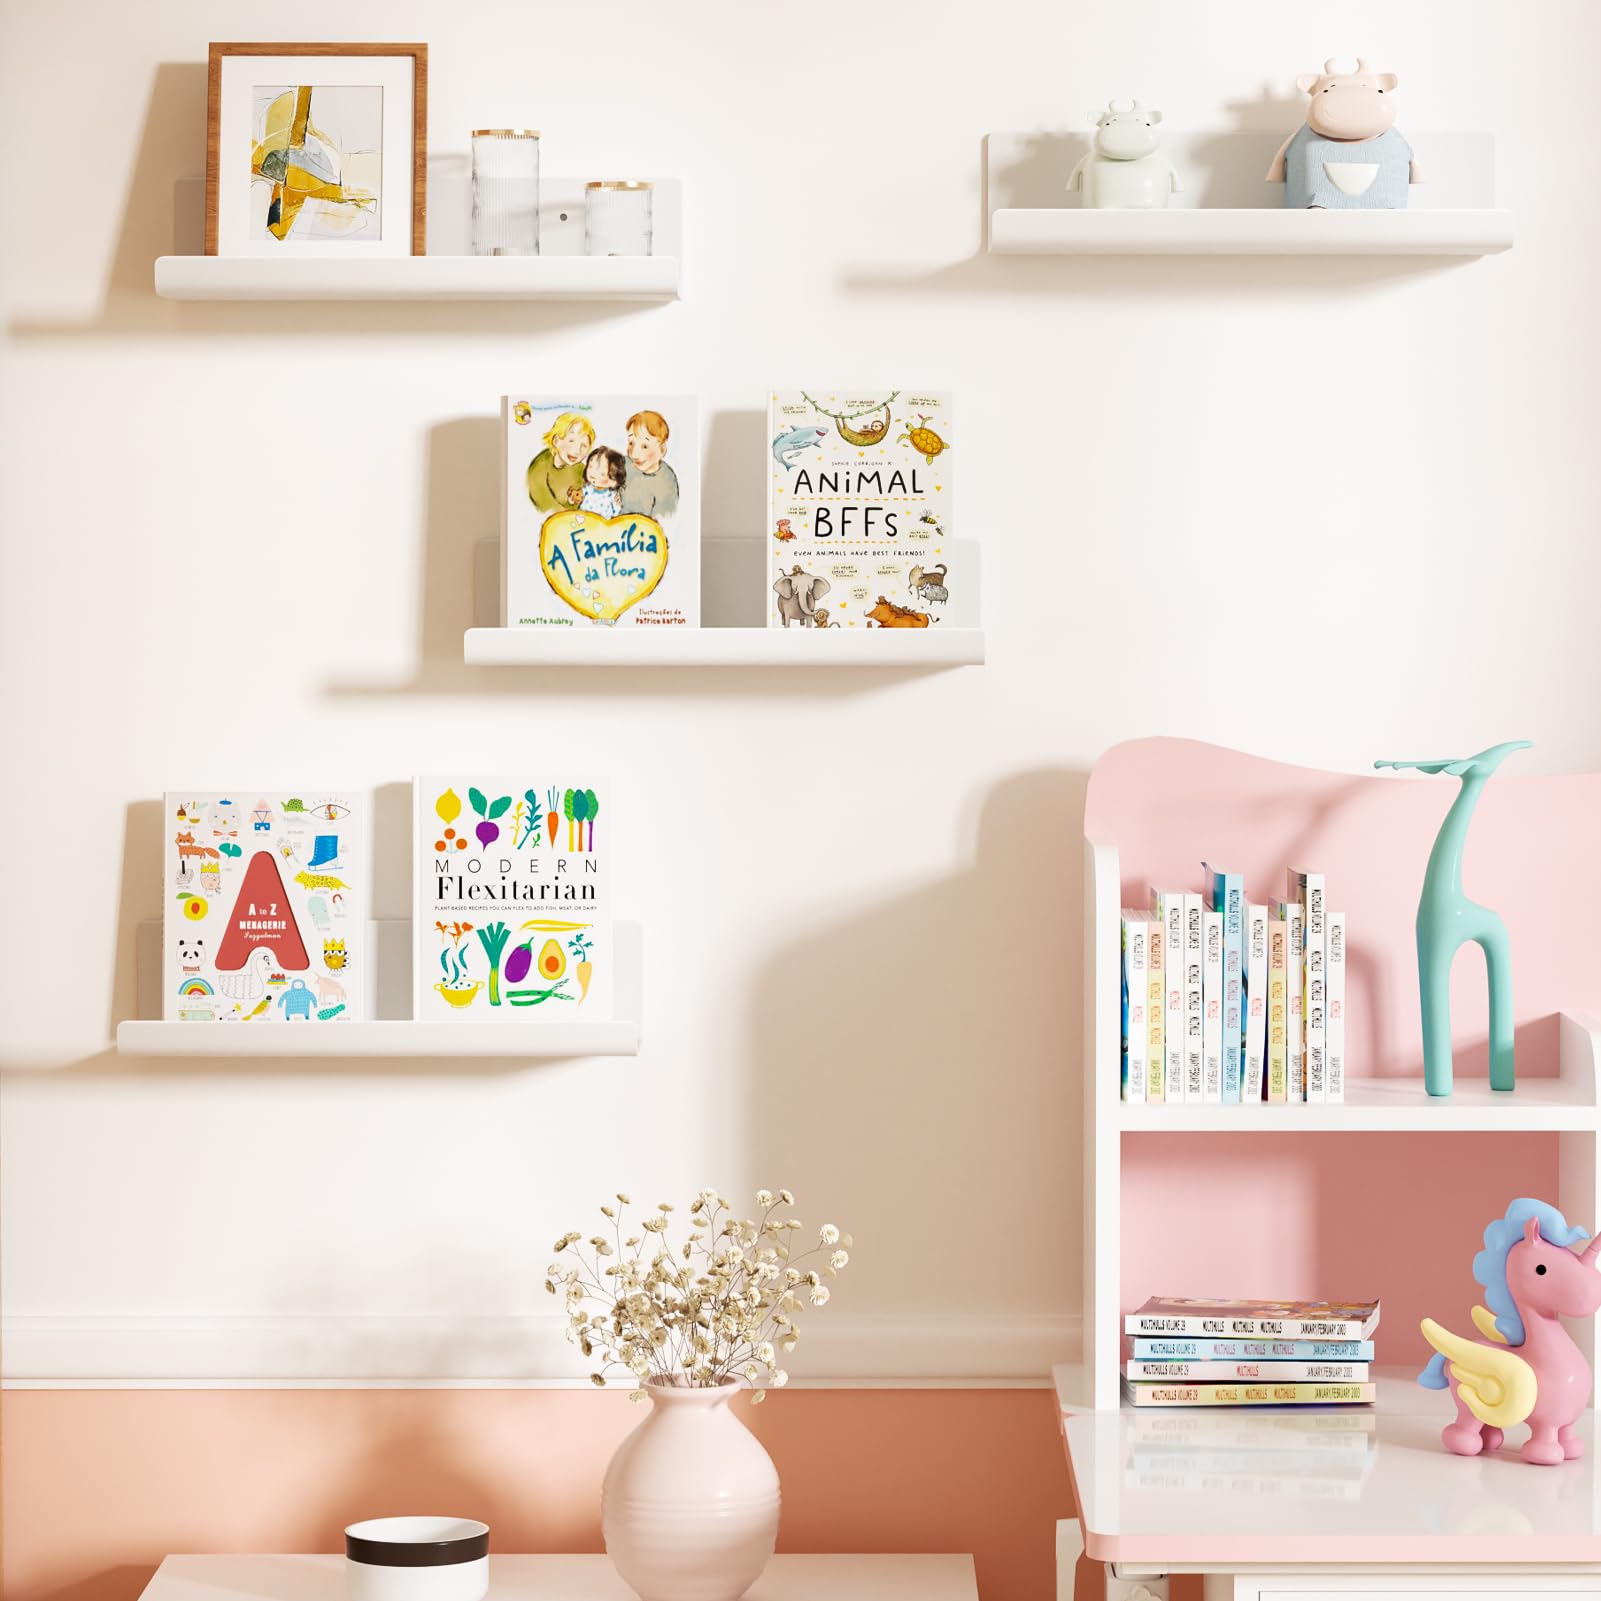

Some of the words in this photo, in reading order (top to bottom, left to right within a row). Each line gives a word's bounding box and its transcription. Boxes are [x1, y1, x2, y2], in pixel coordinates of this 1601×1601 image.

[814, 506, 898, 538] BFFs
[548, 544, 574, 584] A
[570, 522, 658, 562] Família
[584, 566, 600, 582] da
[604, 557, 646, 581] Flora
[436, 859, 596, 873] MODERN
[435, 876, 596, 900] Flexitarian
[248, 903, 256, 916] A
[270, 903, 277, 916] Z
[240, 920, 286, 930] MENAGERIE
